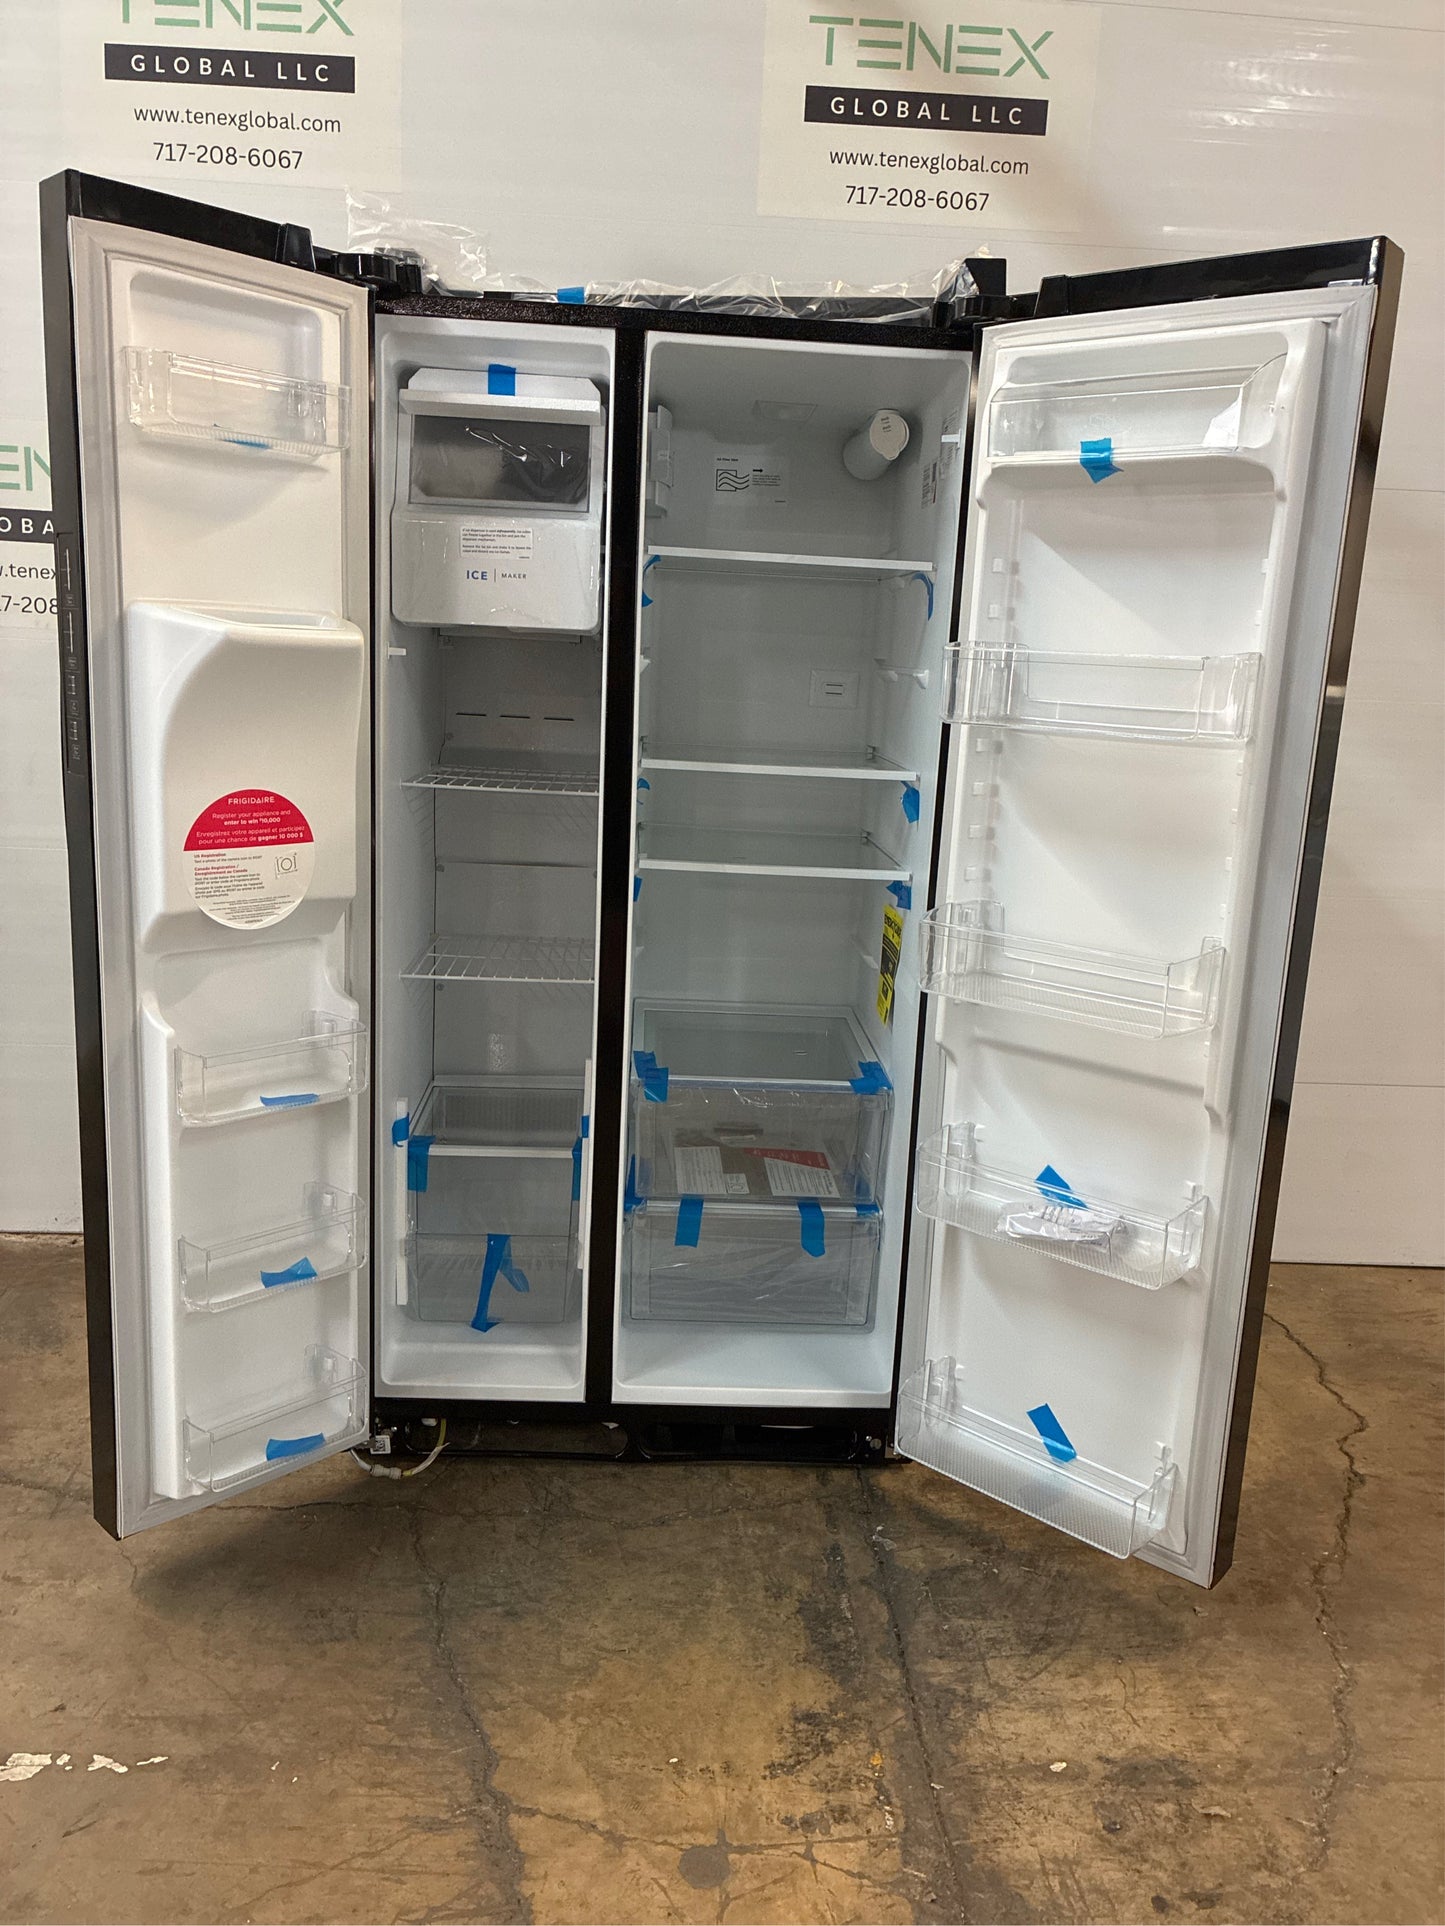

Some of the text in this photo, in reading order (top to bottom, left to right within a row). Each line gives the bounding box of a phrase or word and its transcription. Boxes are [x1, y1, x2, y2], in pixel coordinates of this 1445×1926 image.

[809, 15, 1054, 80] TENEX
[130, 55, 329, 82] GLOBAL LLC
[134, 108, 341, 132] www.tenexglobal.com
[830, 97, 1022, 124] GLOBAL LLC
[153, 142, 303, 170] 717-208-6067
[830, 151, 1028, 174] www.tenexglobal.com
[846, 186, 989, 211] 717-208-6067
[466, 570, 488, 580] ICE
[228, 796, 275, 805] FRIGIDAIRE
[252, 810, 279, 818] appliance
[196, 830, 230, 838] Enregistrez
[248, 828, 270, 836] appareil
[279, 826, 305, 834] participez
